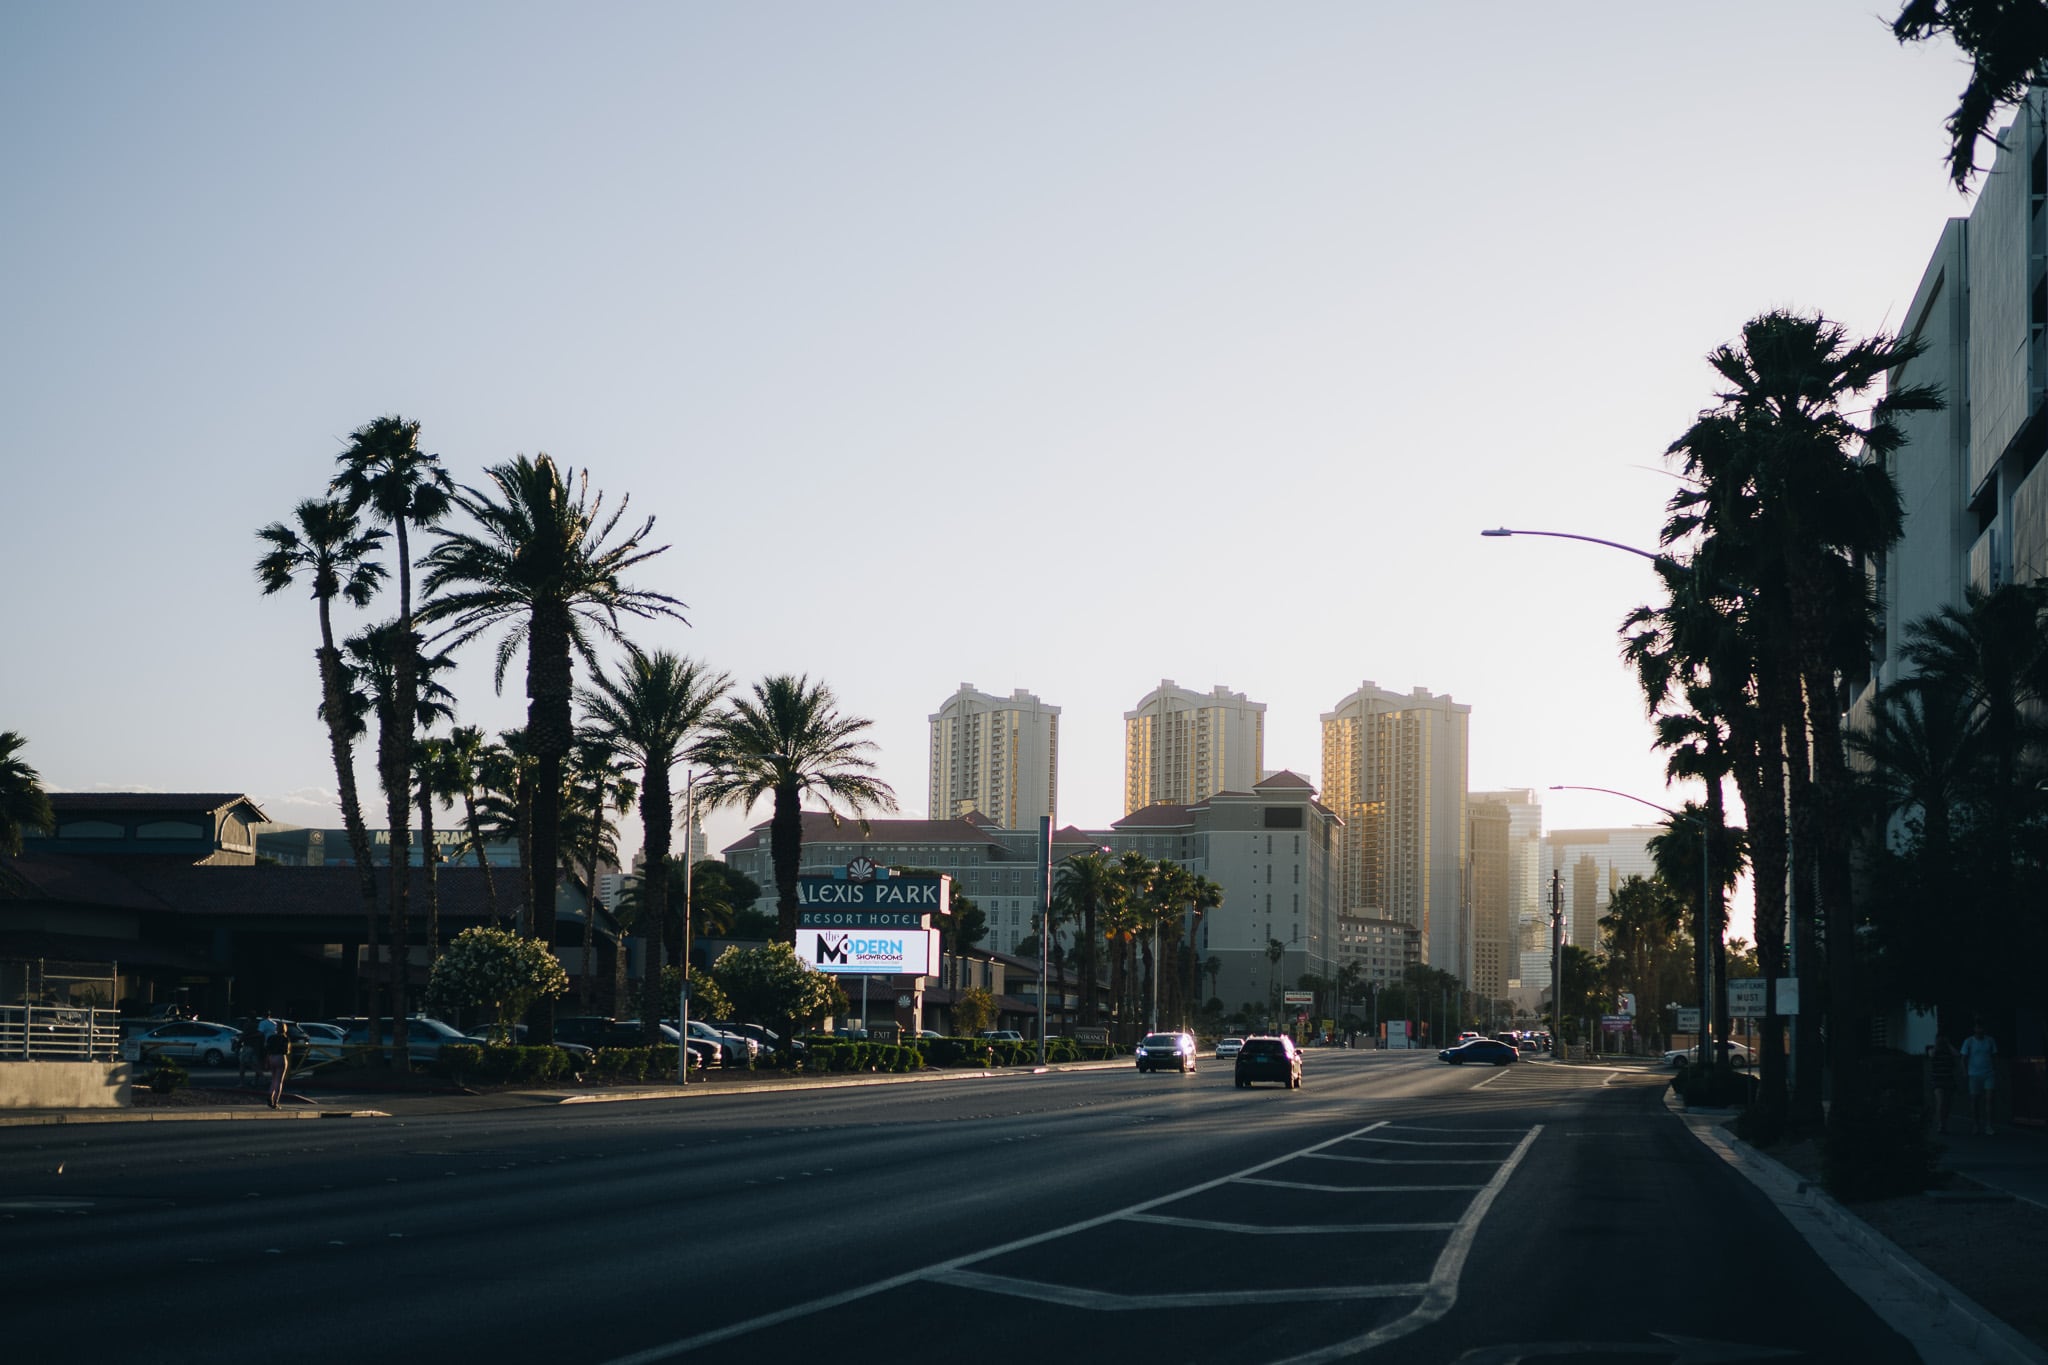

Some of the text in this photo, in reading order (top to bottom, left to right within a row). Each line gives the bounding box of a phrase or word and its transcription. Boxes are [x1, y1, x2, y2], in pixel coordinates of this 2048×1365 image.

[875, 885, 937, 904] PARK
[803, 914, 919, 924] RESORT HOTEL
[825, 931, 840, 942] the
[1737, 994, 1759, 1002] MUST
[873, 1031, 891, 1040] EXIT
